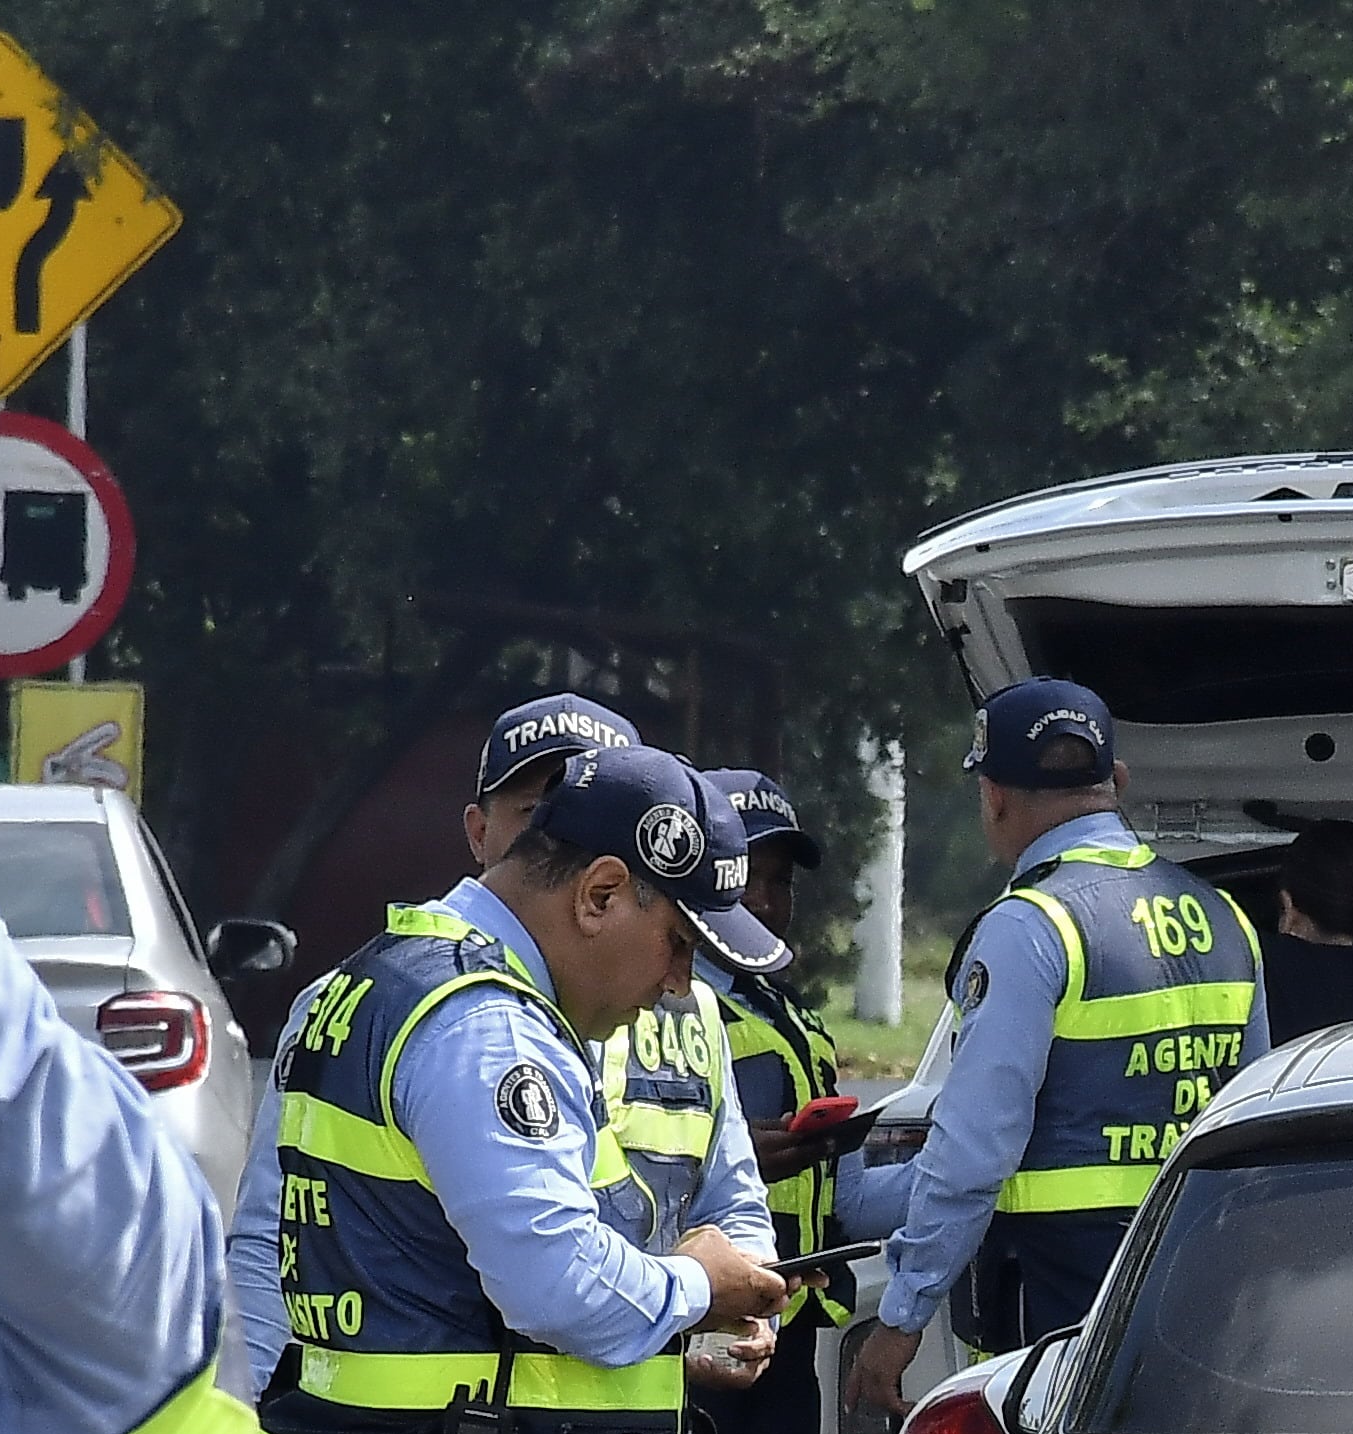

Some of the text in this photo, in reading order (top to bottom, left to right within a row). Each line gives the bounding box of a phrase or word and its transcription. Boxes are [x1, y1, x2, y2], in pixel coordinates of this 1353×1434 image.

[1026, 708, 1087, 741] MOVILIDAD
[1131, 894, 1213, 958] 169
[633, 1007, 712, 1079] 646
[1124, 1031, 1242, 1078] AGENTE
[1173, 1075, 1212, 1116] DE
[1101, 1121, 1190, 1162] TRA
[280, 1173, 331, 1227] ETE
